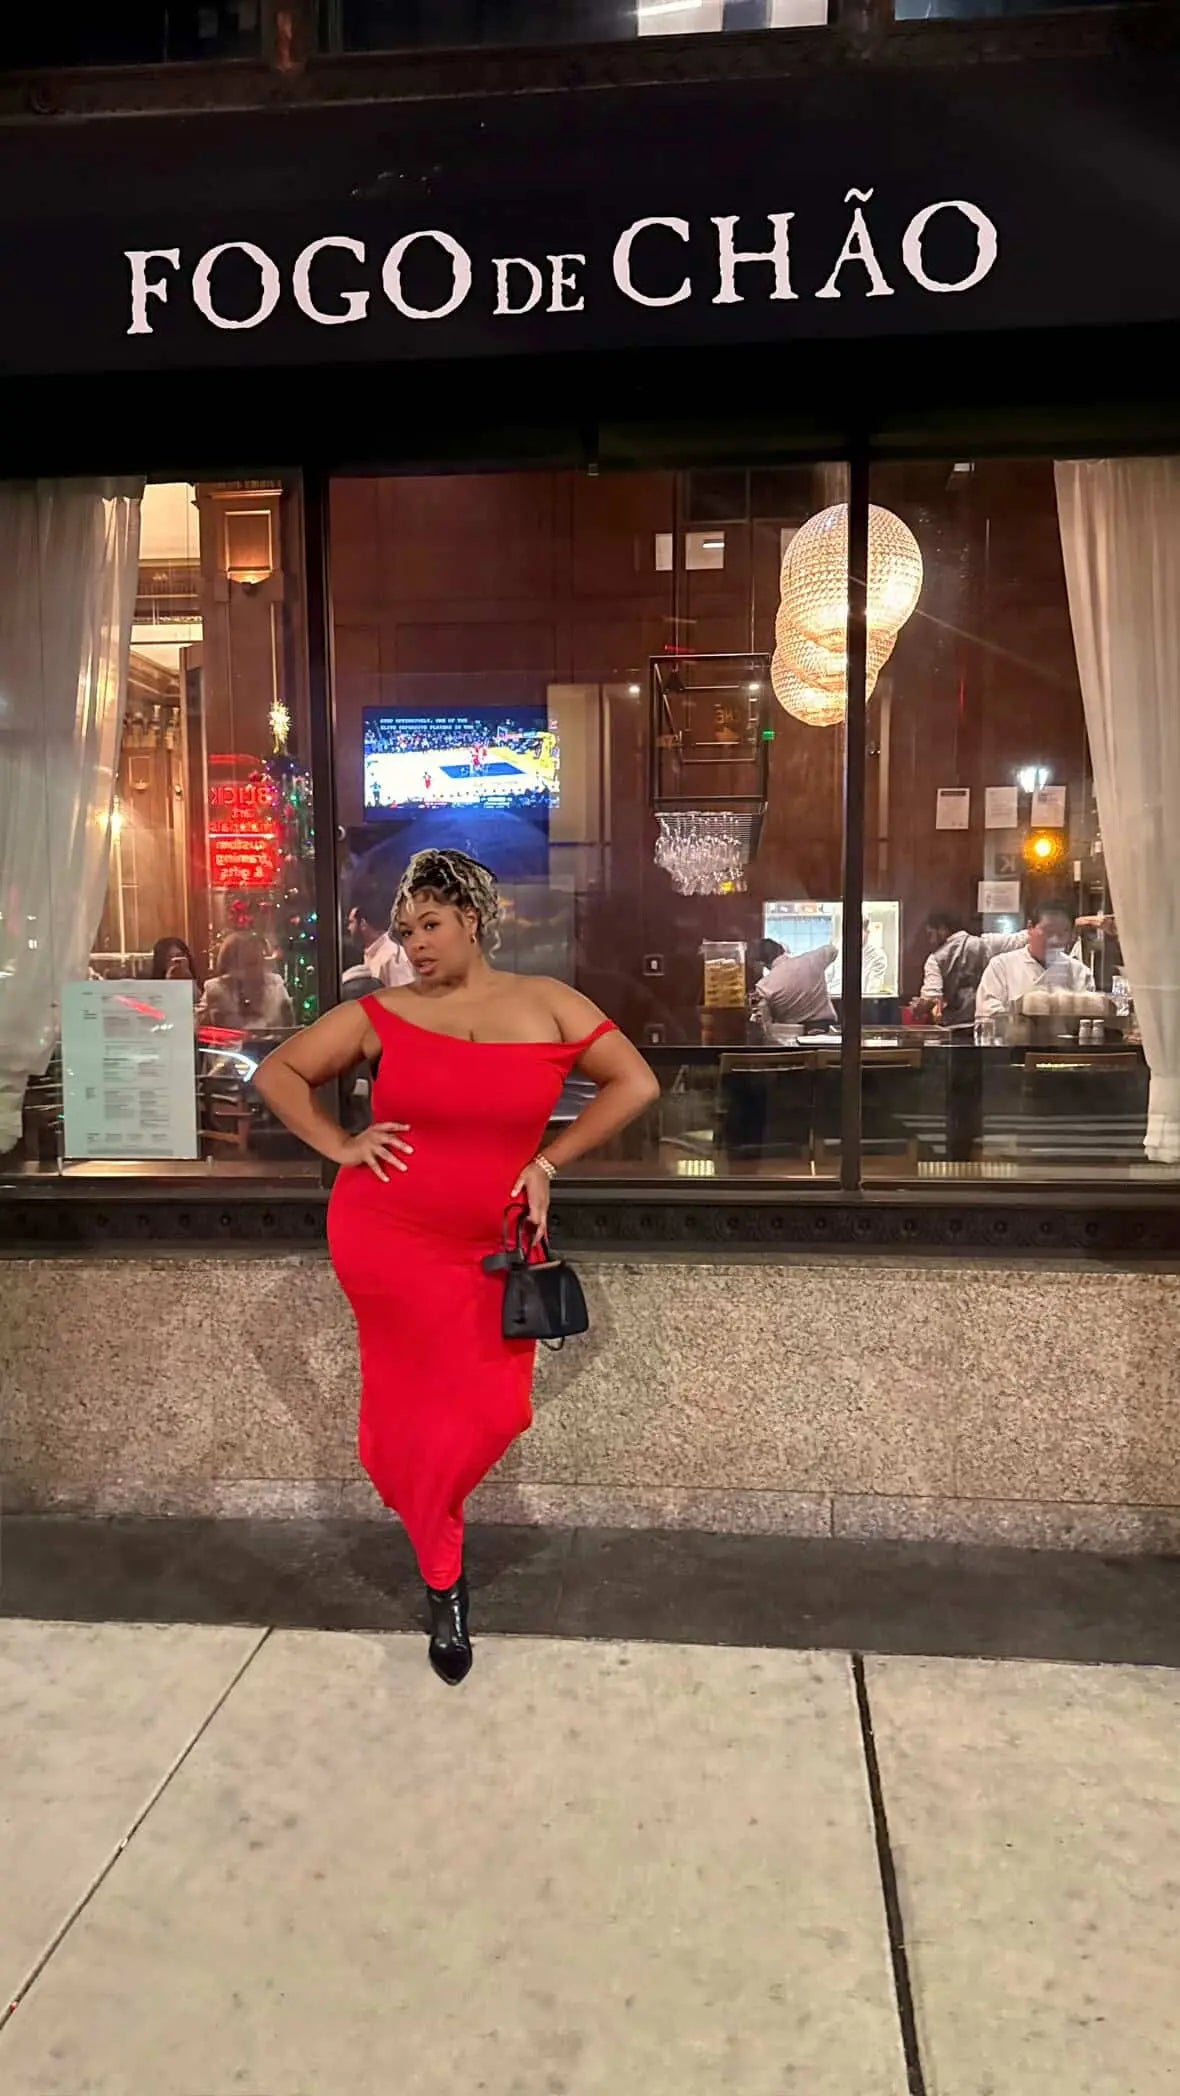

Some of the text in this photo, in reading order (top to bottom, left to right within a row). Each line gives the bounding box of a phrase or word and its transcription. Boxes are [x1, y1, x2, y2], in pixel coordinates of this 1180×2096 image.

[124, 187, 998, 335] FOGO DE CHÃO
